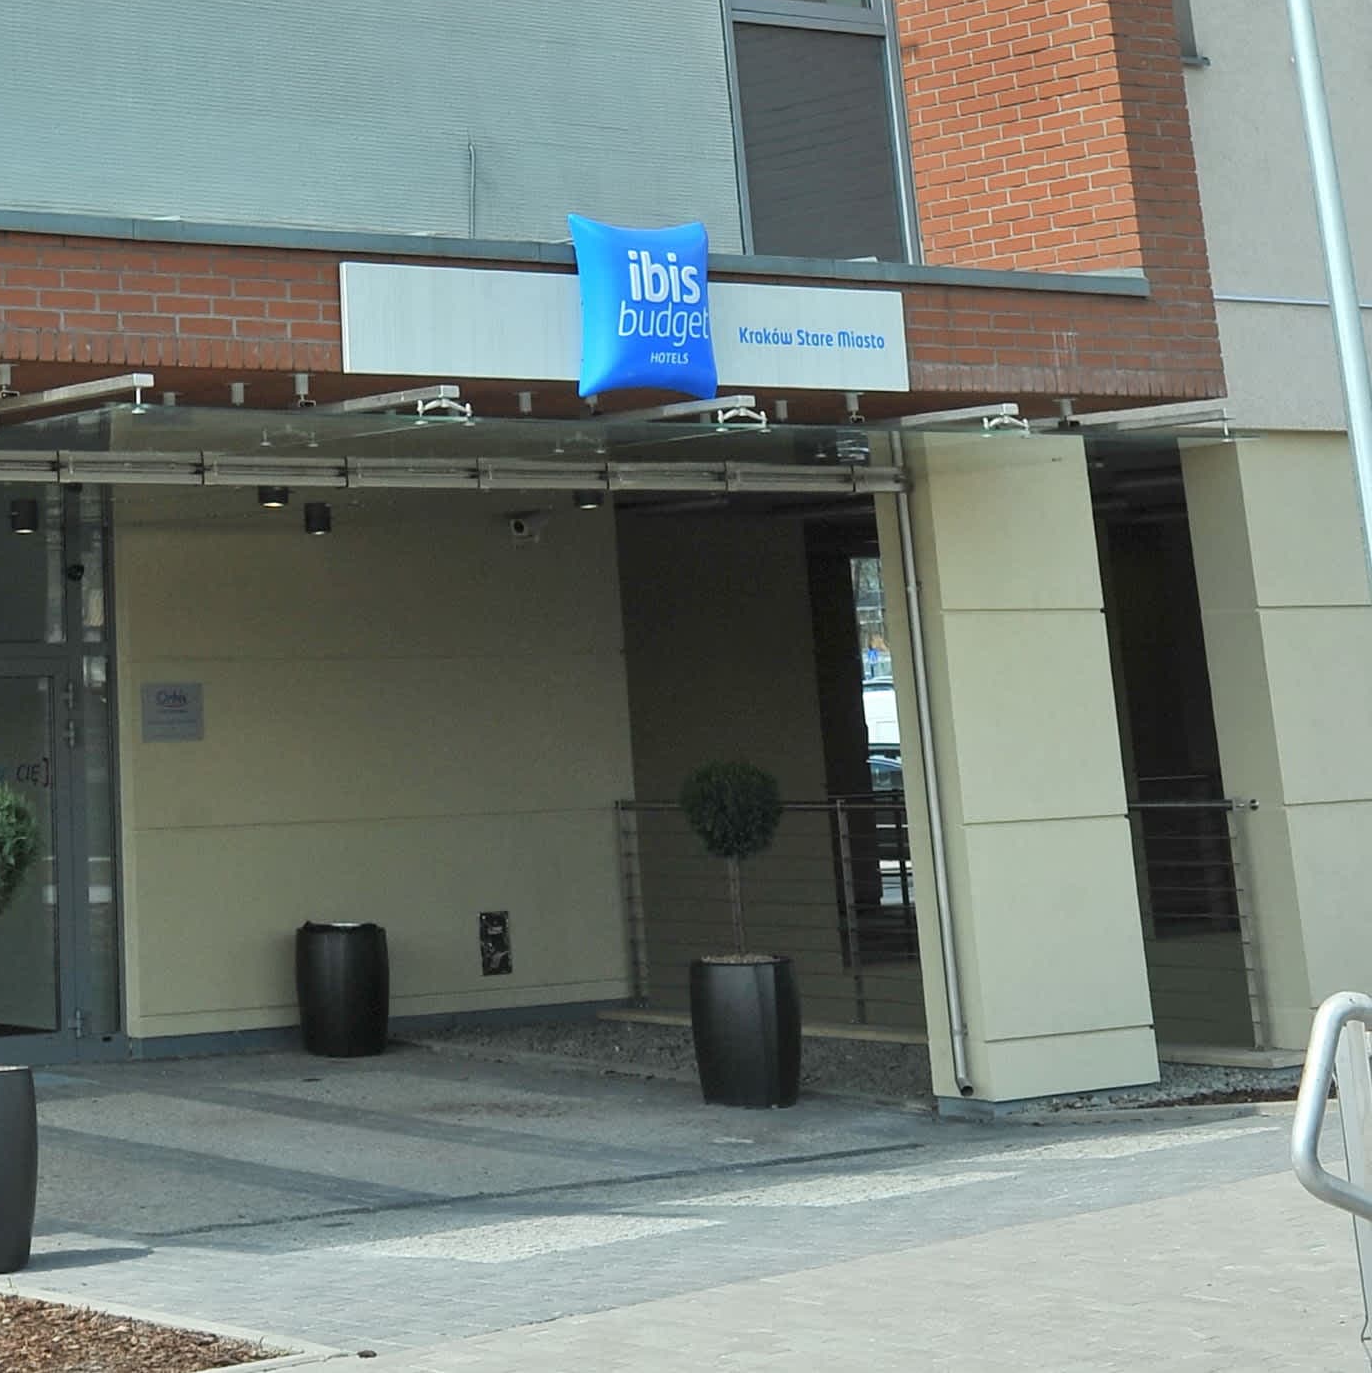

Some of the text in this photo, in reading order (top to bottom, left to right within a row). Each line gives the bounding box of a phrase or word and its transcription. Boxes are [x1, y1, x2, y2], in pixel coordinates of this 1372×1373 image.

[628, 250, 701, 304] ibis
[618, 300, 709, 347] budget
[739, 327, 885, 349] Kraków Stare Miasto
[650, 352, 689, 364] HOTELS
